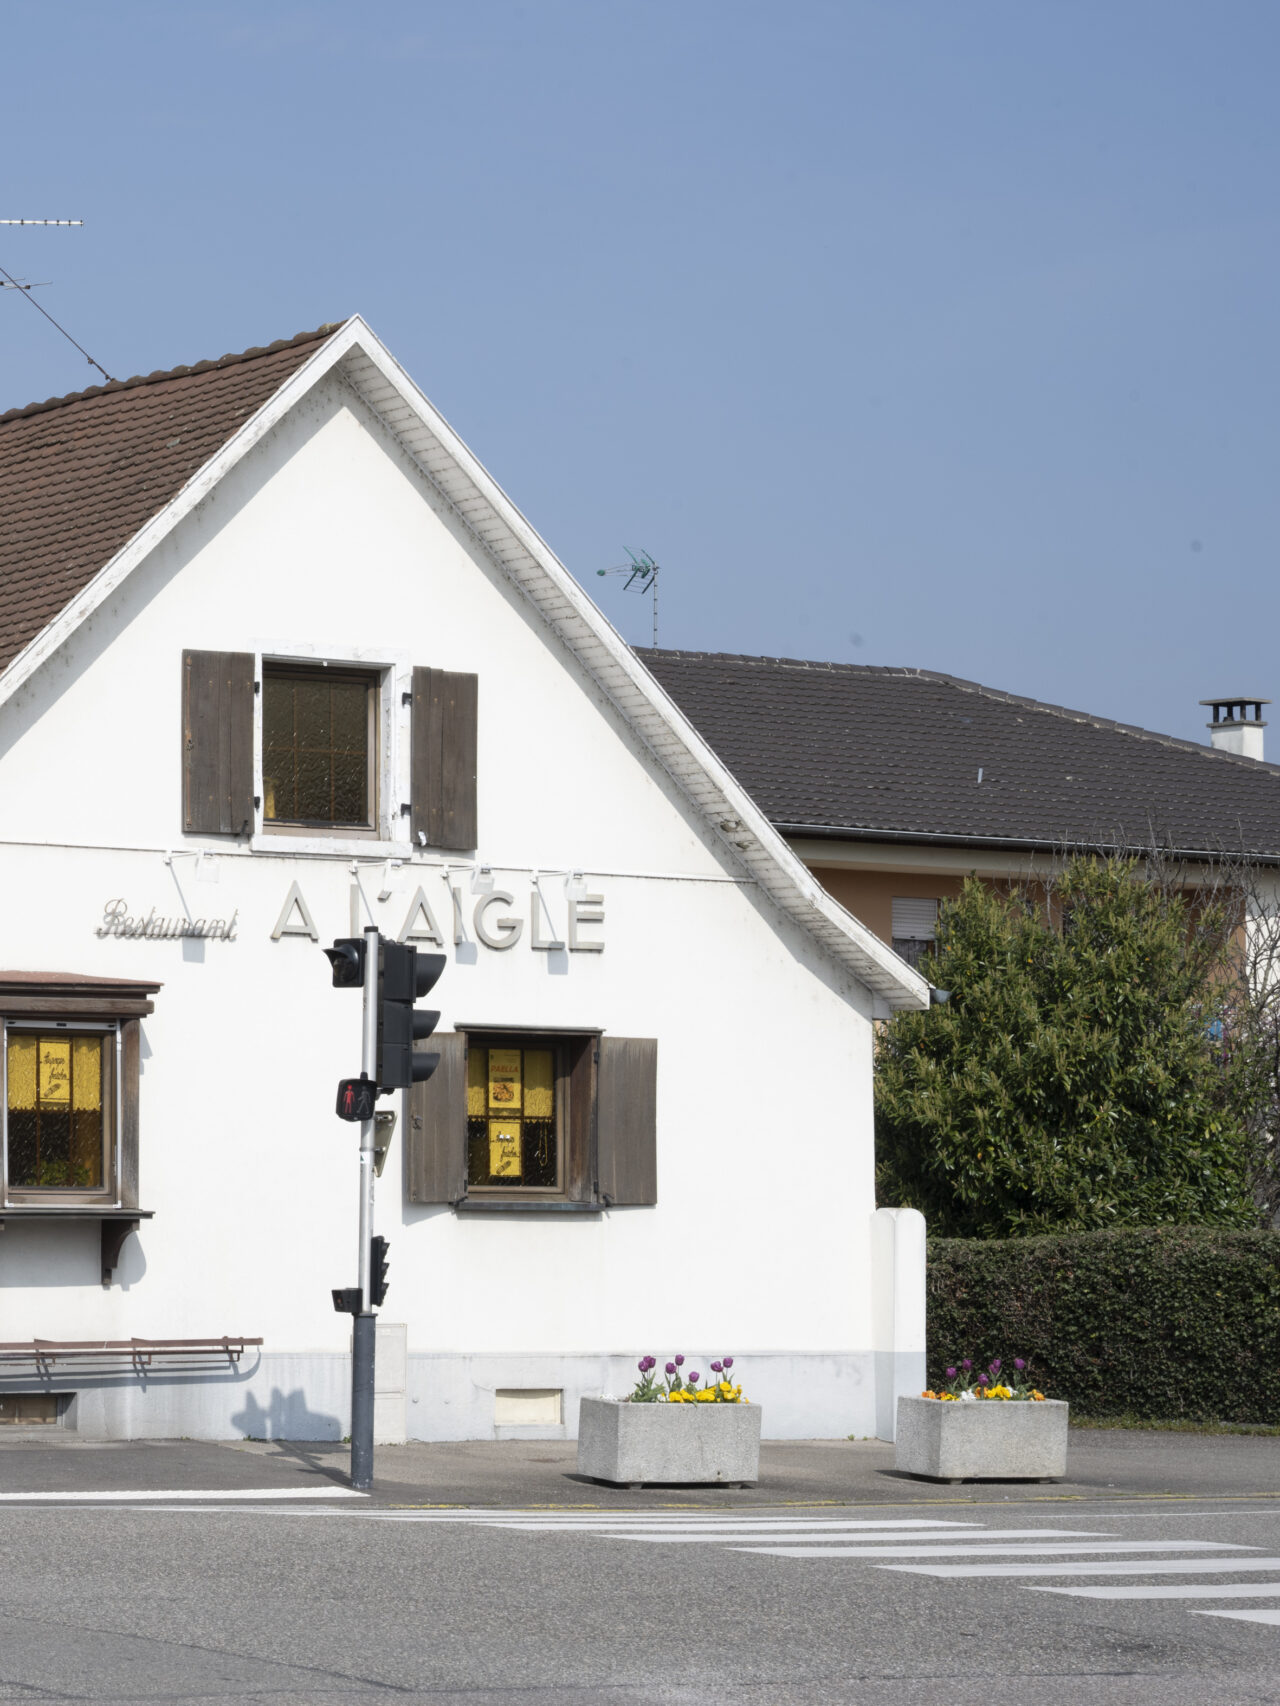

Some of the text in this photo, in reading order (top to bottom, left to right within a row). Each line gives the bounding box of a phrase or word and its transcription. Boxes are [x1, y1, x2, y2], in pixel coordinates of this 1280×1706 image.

[94, 879, 605, 952] Restaurant A L'AIGLE
